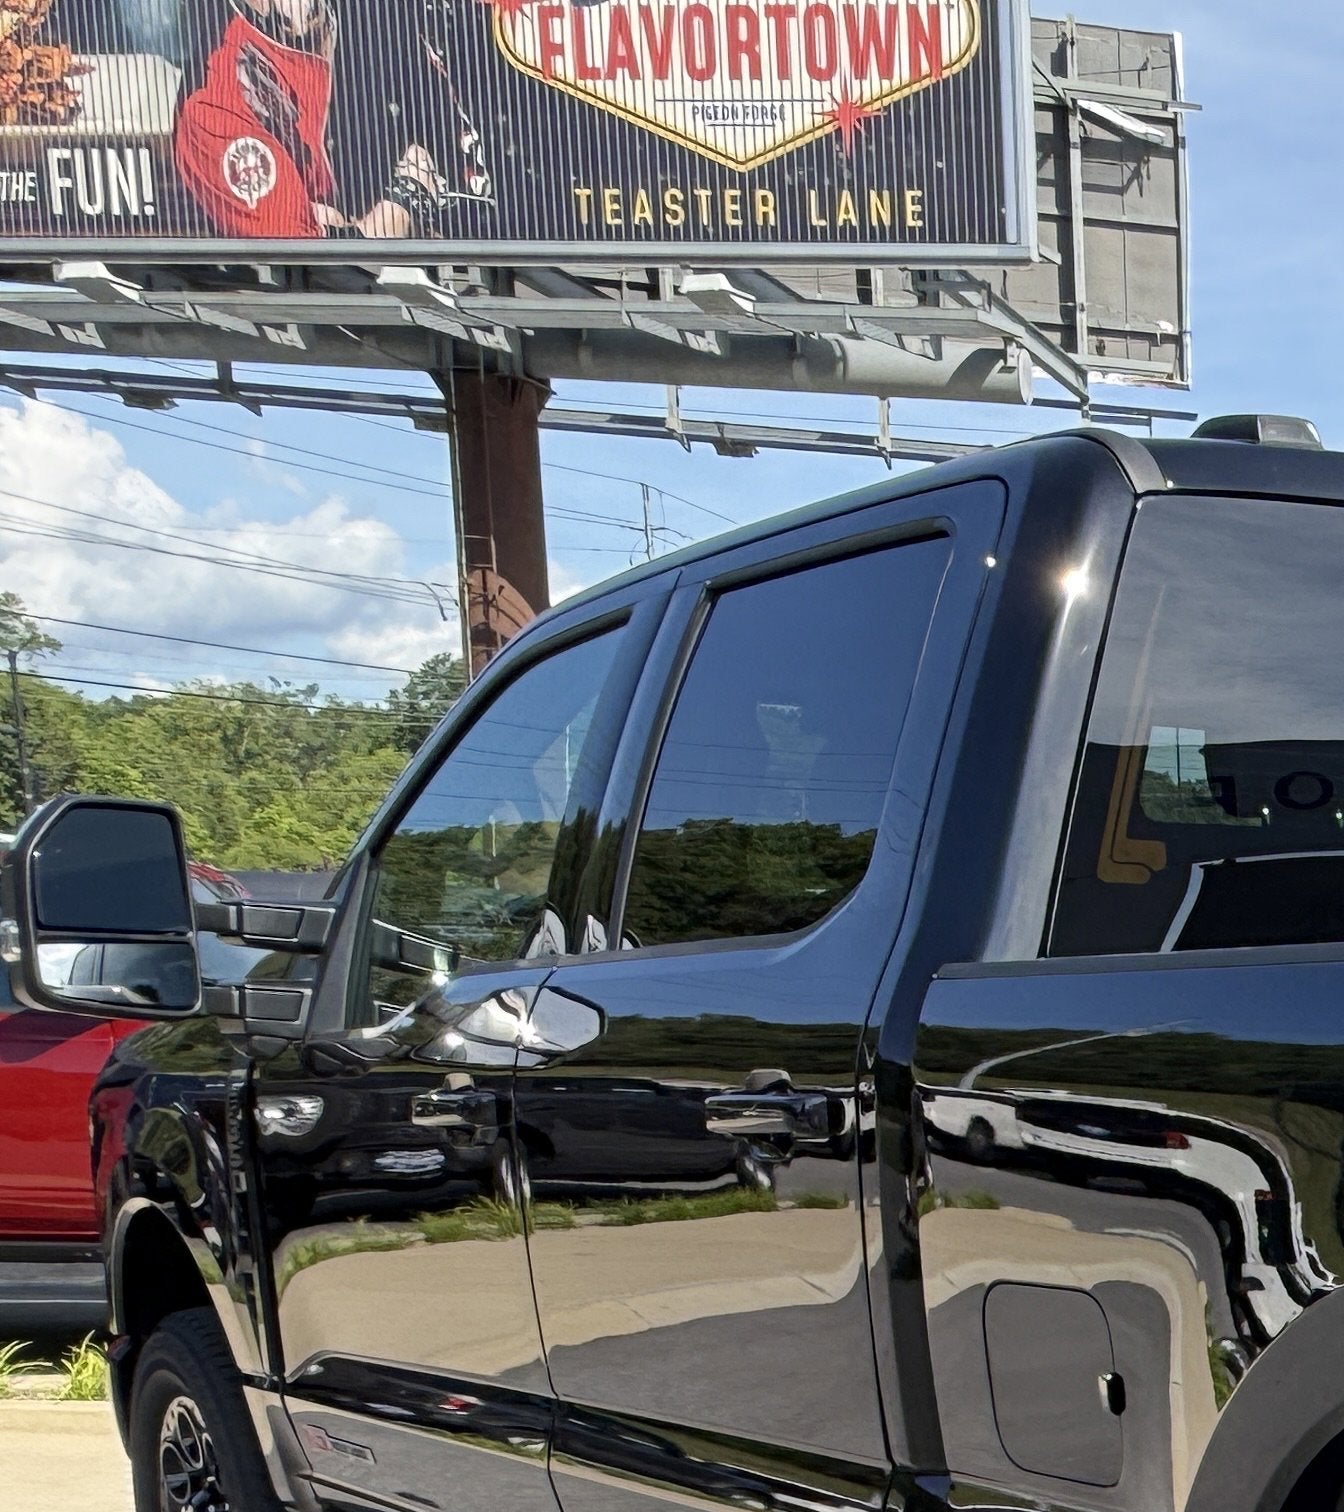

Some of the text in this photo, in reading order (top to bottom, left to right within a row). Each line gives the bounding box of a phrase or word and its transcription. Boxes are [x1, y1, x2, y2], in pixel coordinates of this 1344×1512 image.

[534, 2, 943, 82] FLAVORTOWN
[0, 148, 156, 217] THE FUN!
[573, 188, 925, 228] TEASTER LANE
